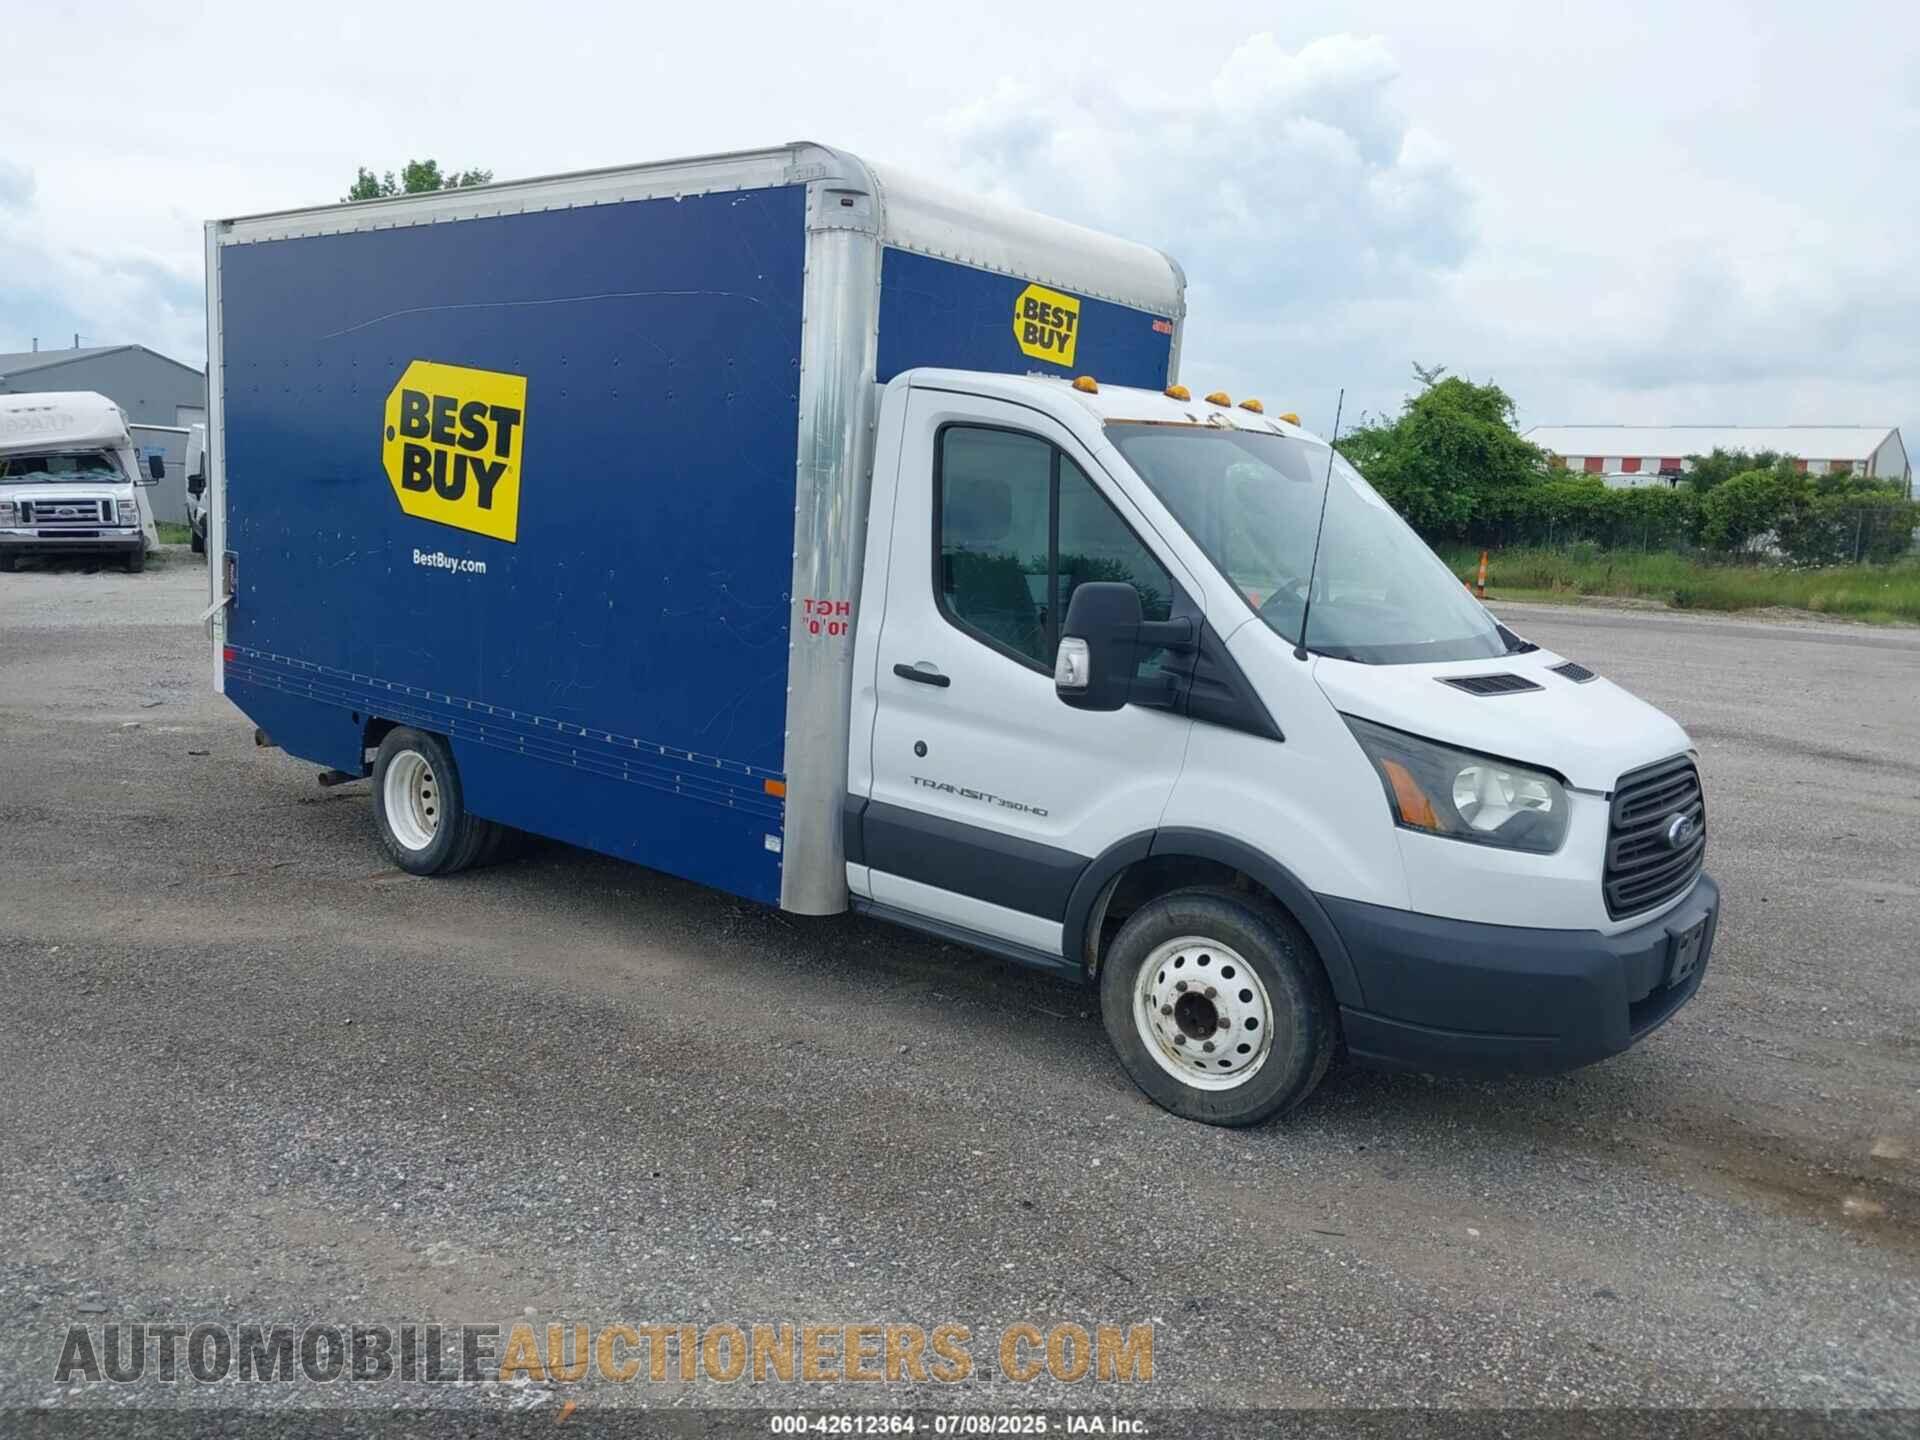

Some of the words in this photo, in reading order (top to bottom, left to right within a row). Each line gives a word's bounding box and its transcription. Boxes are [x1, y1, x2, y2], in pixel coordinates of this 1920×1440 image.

[1023, 297, 1076, 332] BEST
[1023, 321, 1070, 353] BUY
[400, 388, 521, 458] BEST
[402, 442, 507, 510] BUY
[413, 549, 487, 574] BestBuy.com
